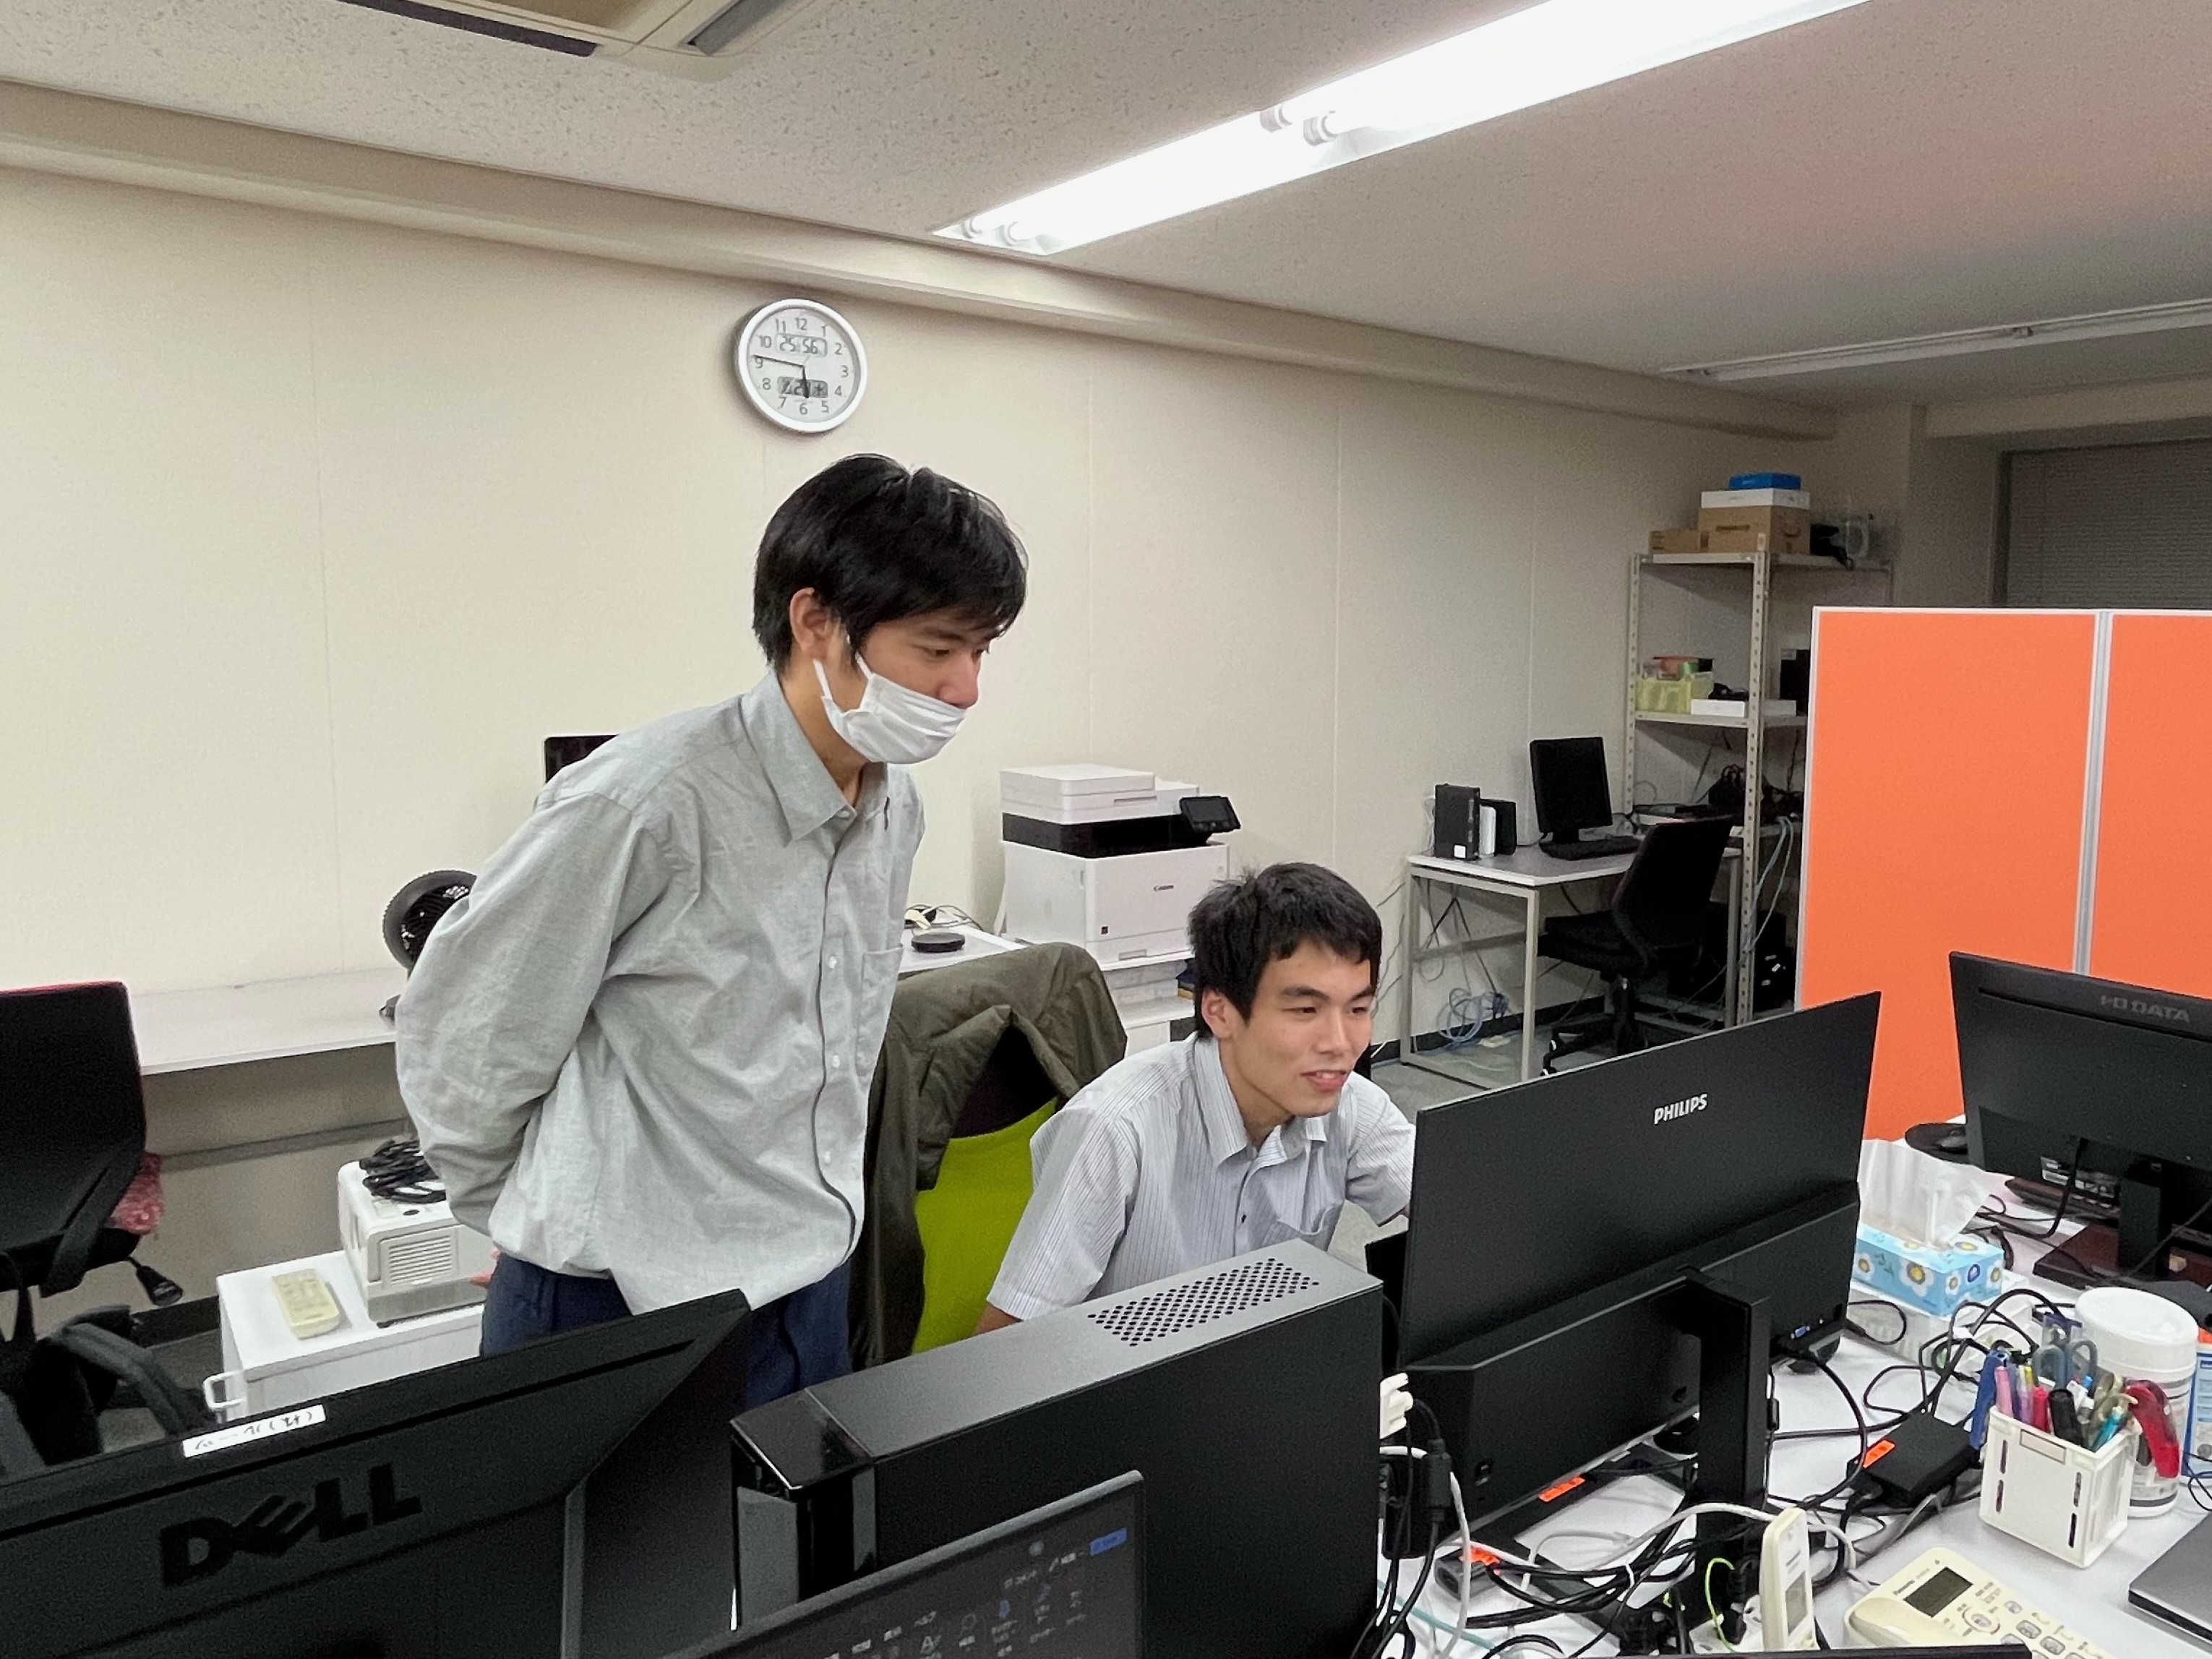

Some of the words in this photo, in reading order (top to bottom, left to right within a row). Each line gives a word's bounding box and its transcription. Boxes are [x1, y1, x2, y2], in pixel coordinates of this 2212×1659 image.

[775, 318, 786, 333] 11
[795, 317, 807, 331] 12
[821, 325, 827, 337] 1
[758, 335, 772, 348] 10
[834, 342, 843, 356] 2
[755, 356, 763, 369] 9
[841, 365, 849, 378] 3
[762, 377, 771, 390] 8
[834, 385, 843, 396] 4
[777, 396, 786, 410] 7
[800, 402, 808, 415] 6
[821, 400, 829, 414] 5
[1654, 1093, 1707, 1125] PHILIPS
[158, 1462, 422, 1587] DELL
